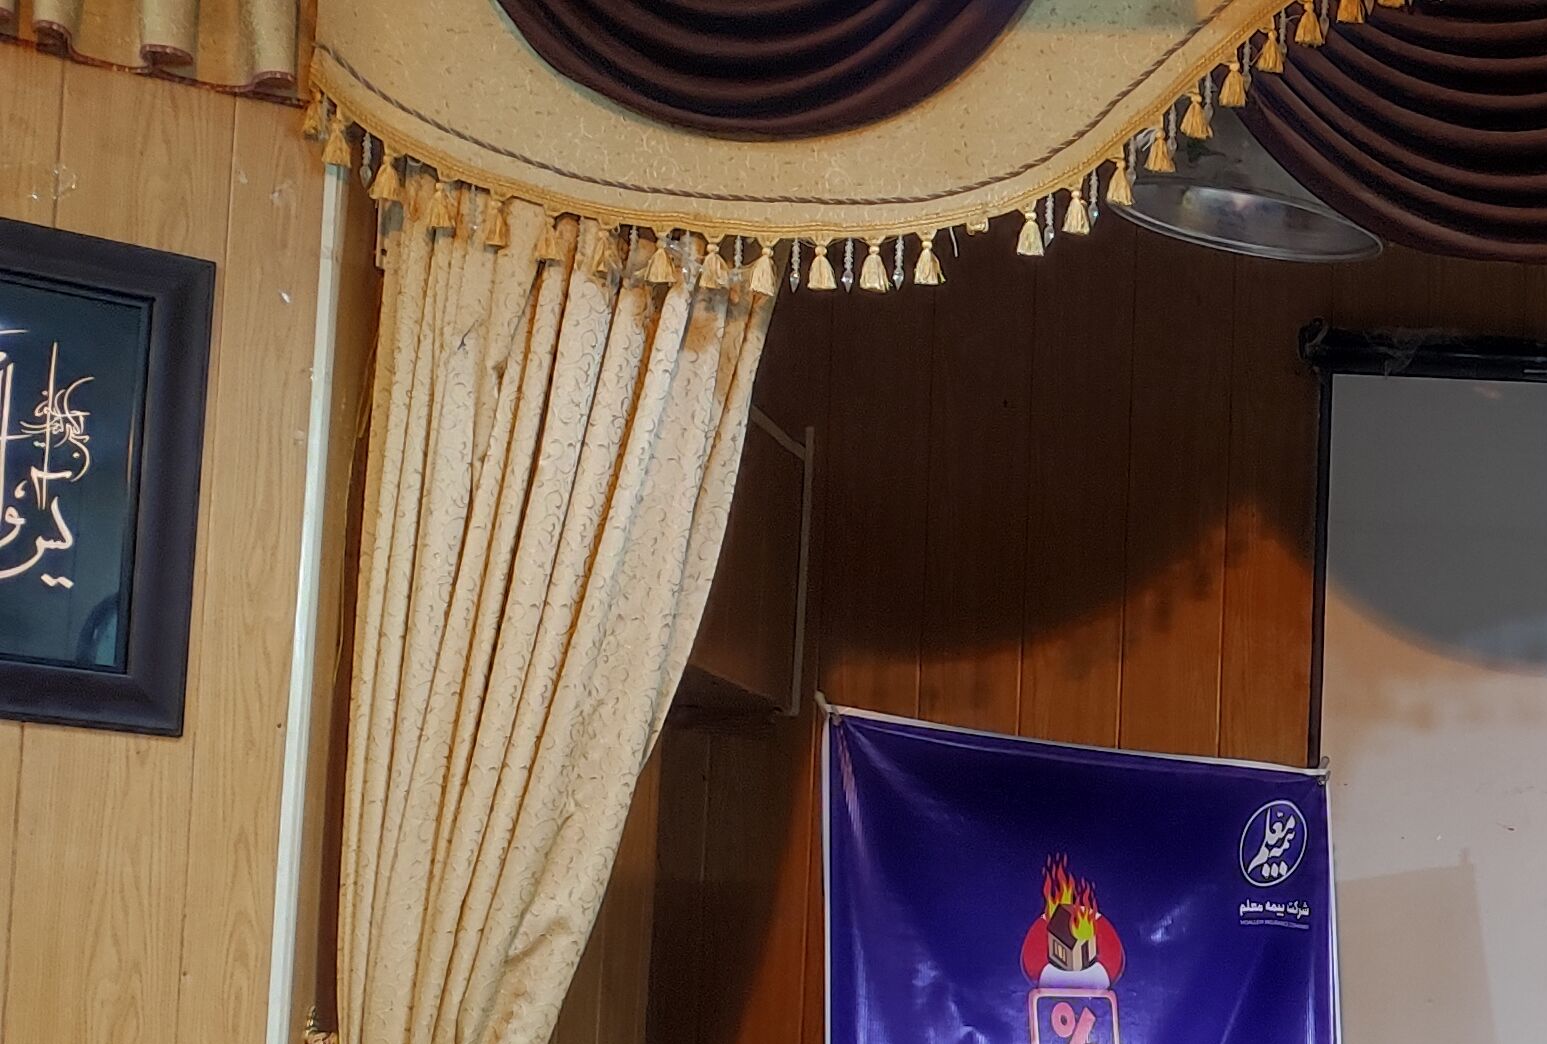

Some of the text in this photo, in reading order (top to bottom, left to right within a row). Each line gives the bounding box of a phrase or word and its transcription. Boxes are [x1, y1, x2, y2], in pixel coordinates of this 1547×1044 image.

[1240, 899, 1309, 919] شرکت بیمه معلم
